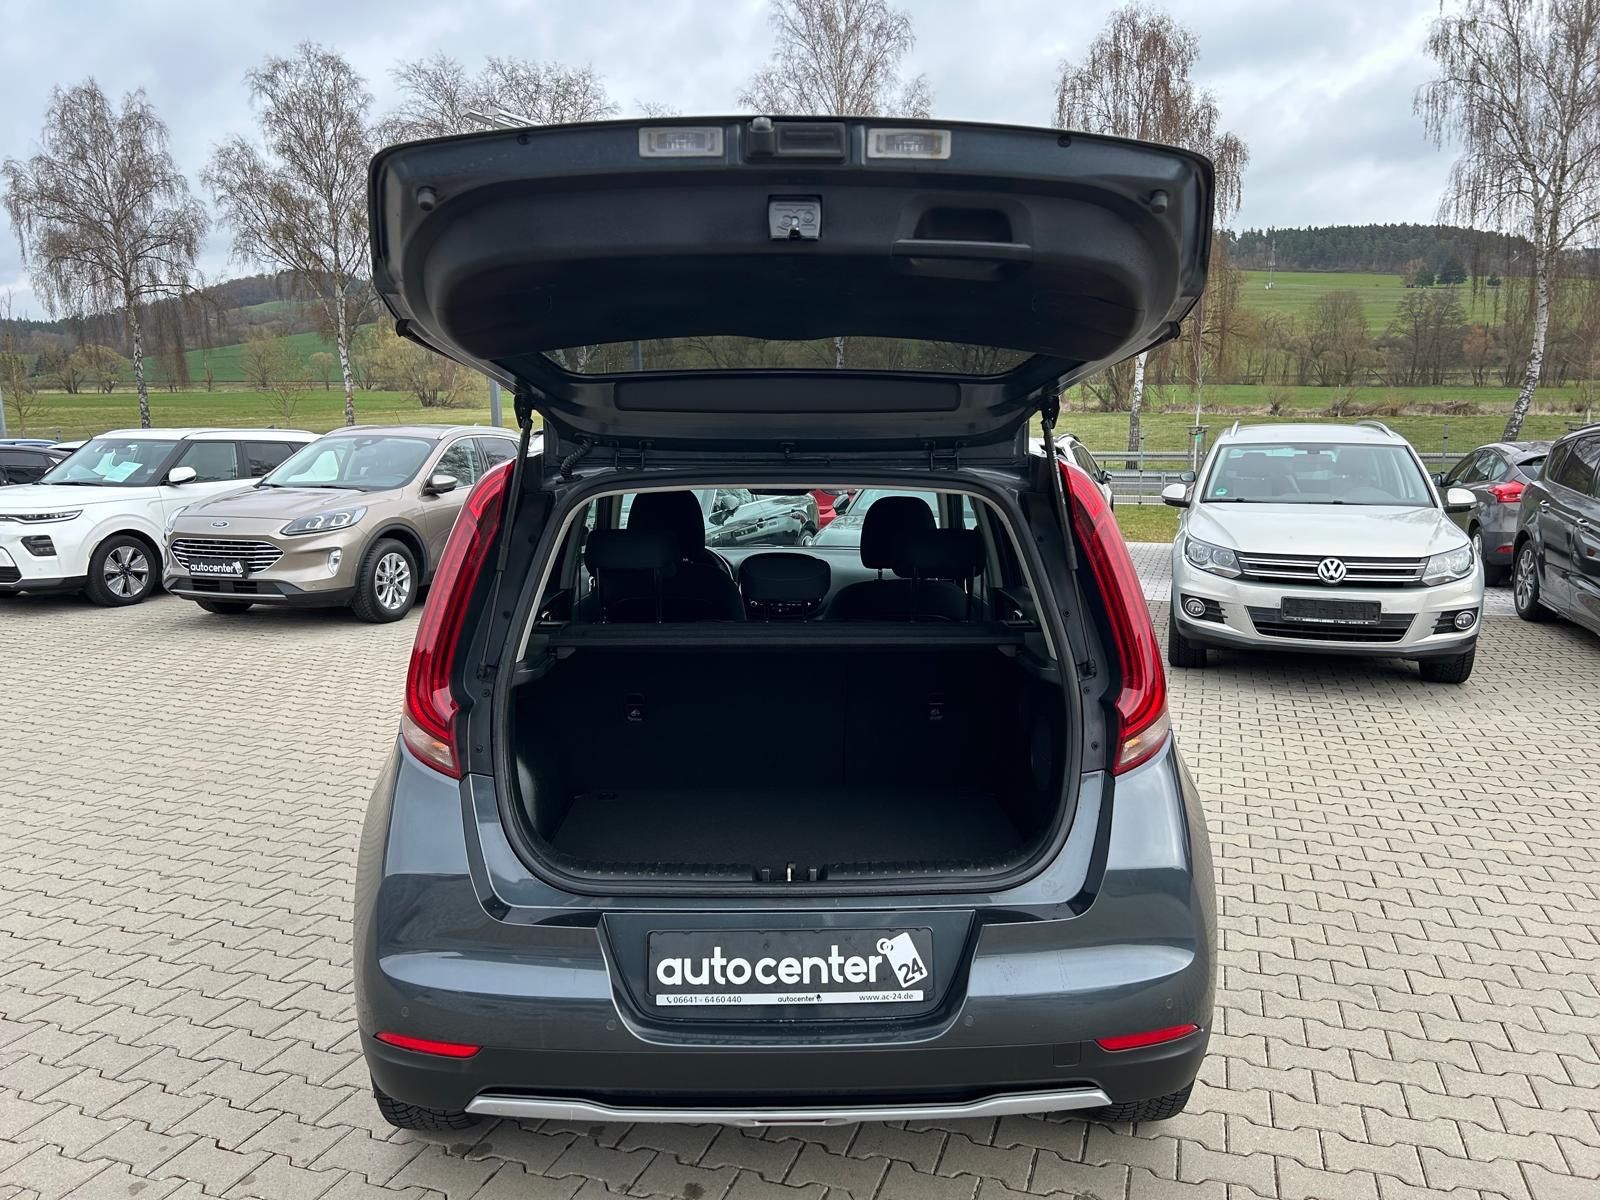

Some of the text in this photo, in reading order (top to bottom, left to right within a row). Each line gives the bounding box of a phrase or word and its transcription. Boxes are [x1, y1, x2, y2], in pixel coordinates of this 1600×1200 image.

[190, 562, 233, 573] autocenter
[656, 945, 882, 985] autocenter
[898, 957, 923, 984] 24
[777, 995, 815, 1003] autocenter
[859, 992, 914, 1001] www.ac-24.de
